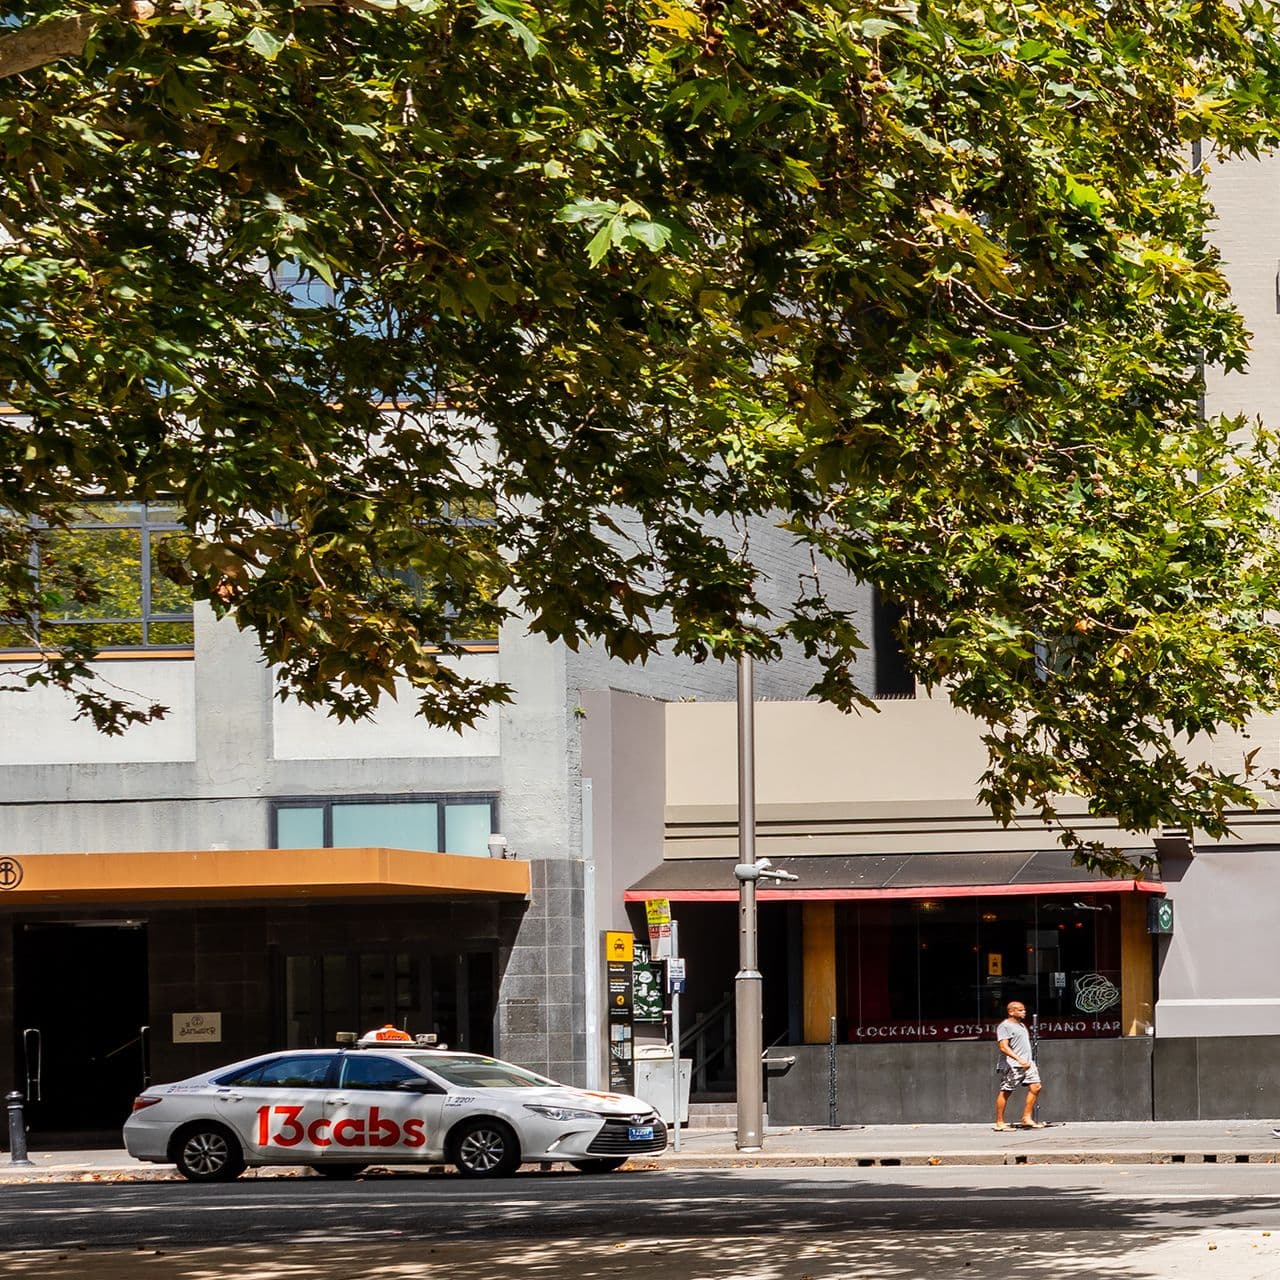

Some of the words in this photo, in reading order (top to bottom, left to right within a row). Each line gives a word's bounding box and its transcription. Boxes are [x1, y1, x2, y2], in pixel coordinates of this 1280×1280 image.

[856, 1025, 937, 1037] COCKTAILS
[1039, 1021, 1086, 1032] PIANO
[1092, 1020, 1121, 1032] BAR
[256, 1105, 426, 1147] 13cabs
